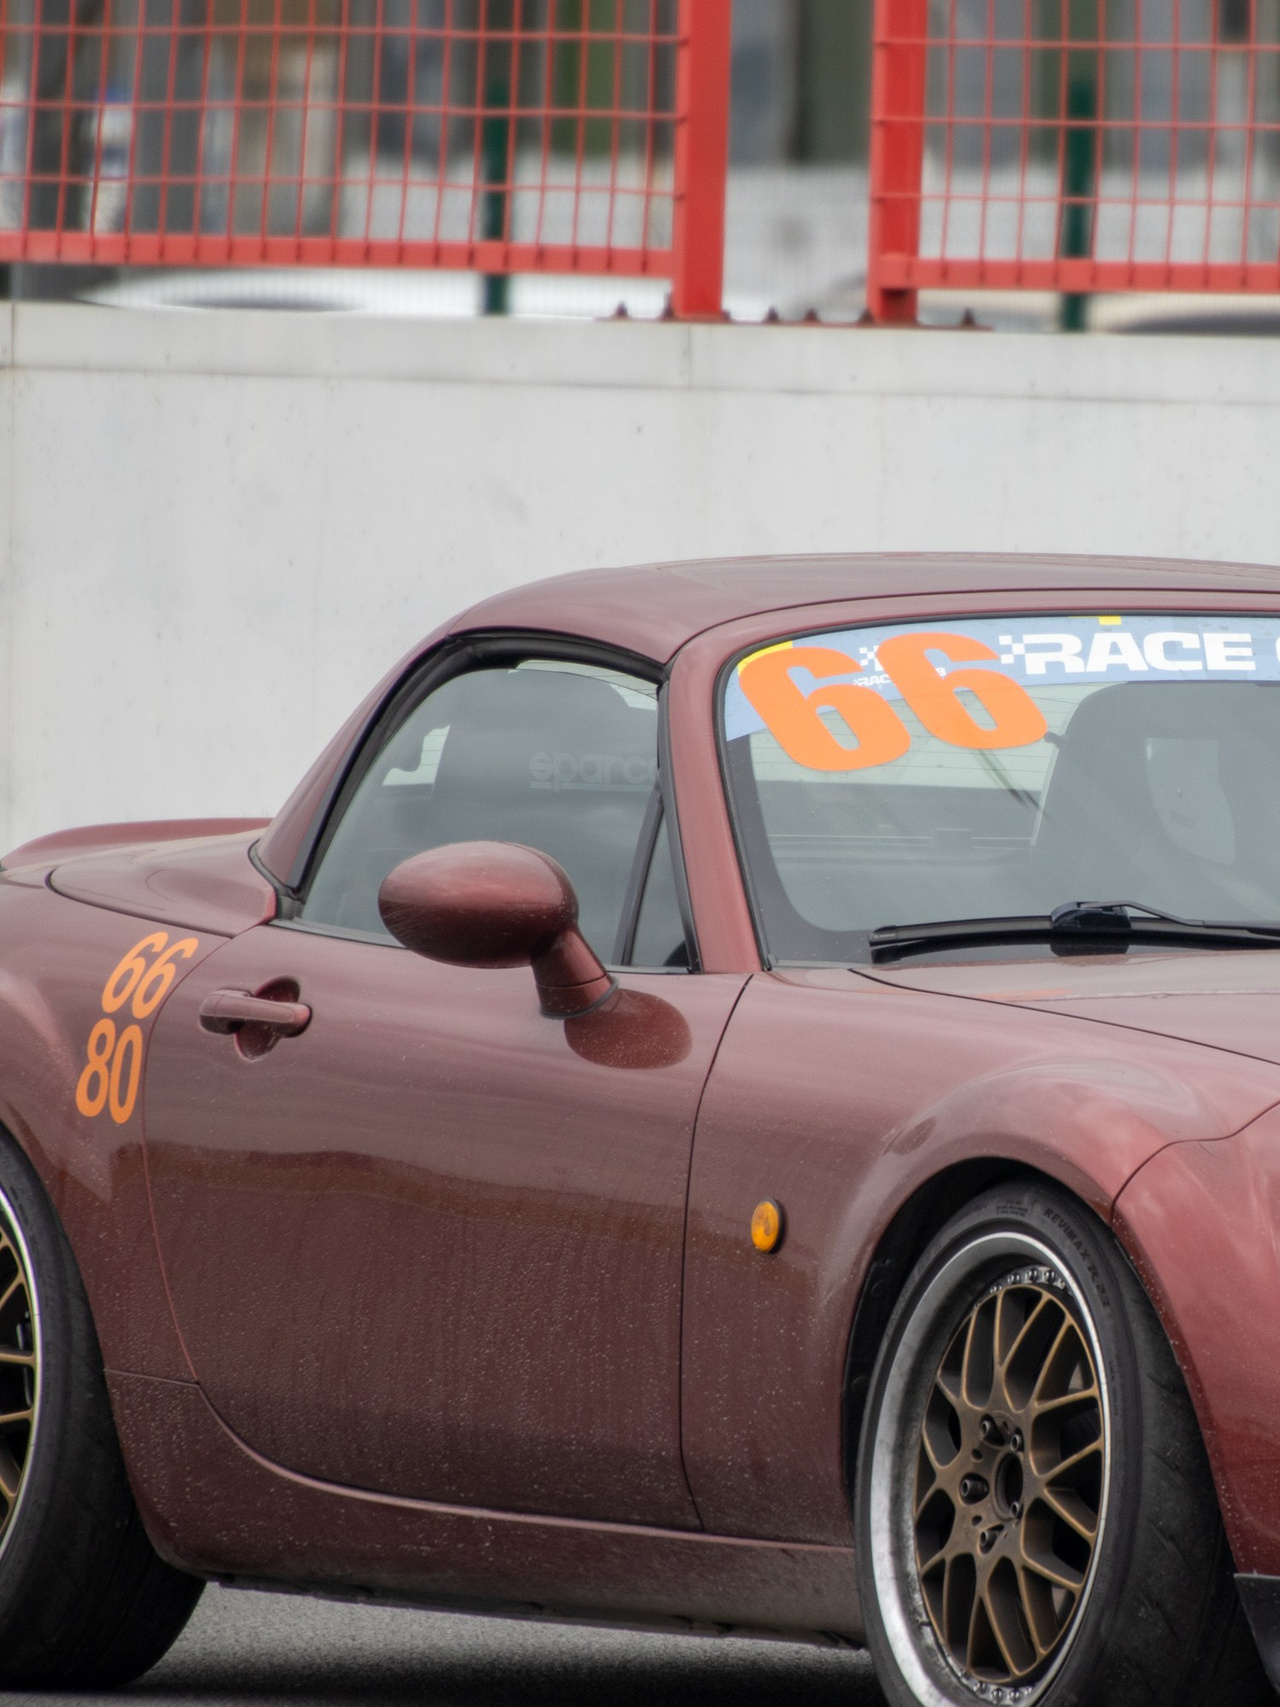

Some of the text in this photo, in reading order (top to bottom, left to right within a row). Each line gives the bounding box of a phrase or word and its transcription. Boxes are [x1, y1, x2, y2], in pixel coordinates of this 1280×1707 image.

[738, 632, 1048, 772] 66
[1025, 632, 1256, 675] RACE
[101, 931, 198, 1019] 66
[75, 1018, 143, 1124] 80
